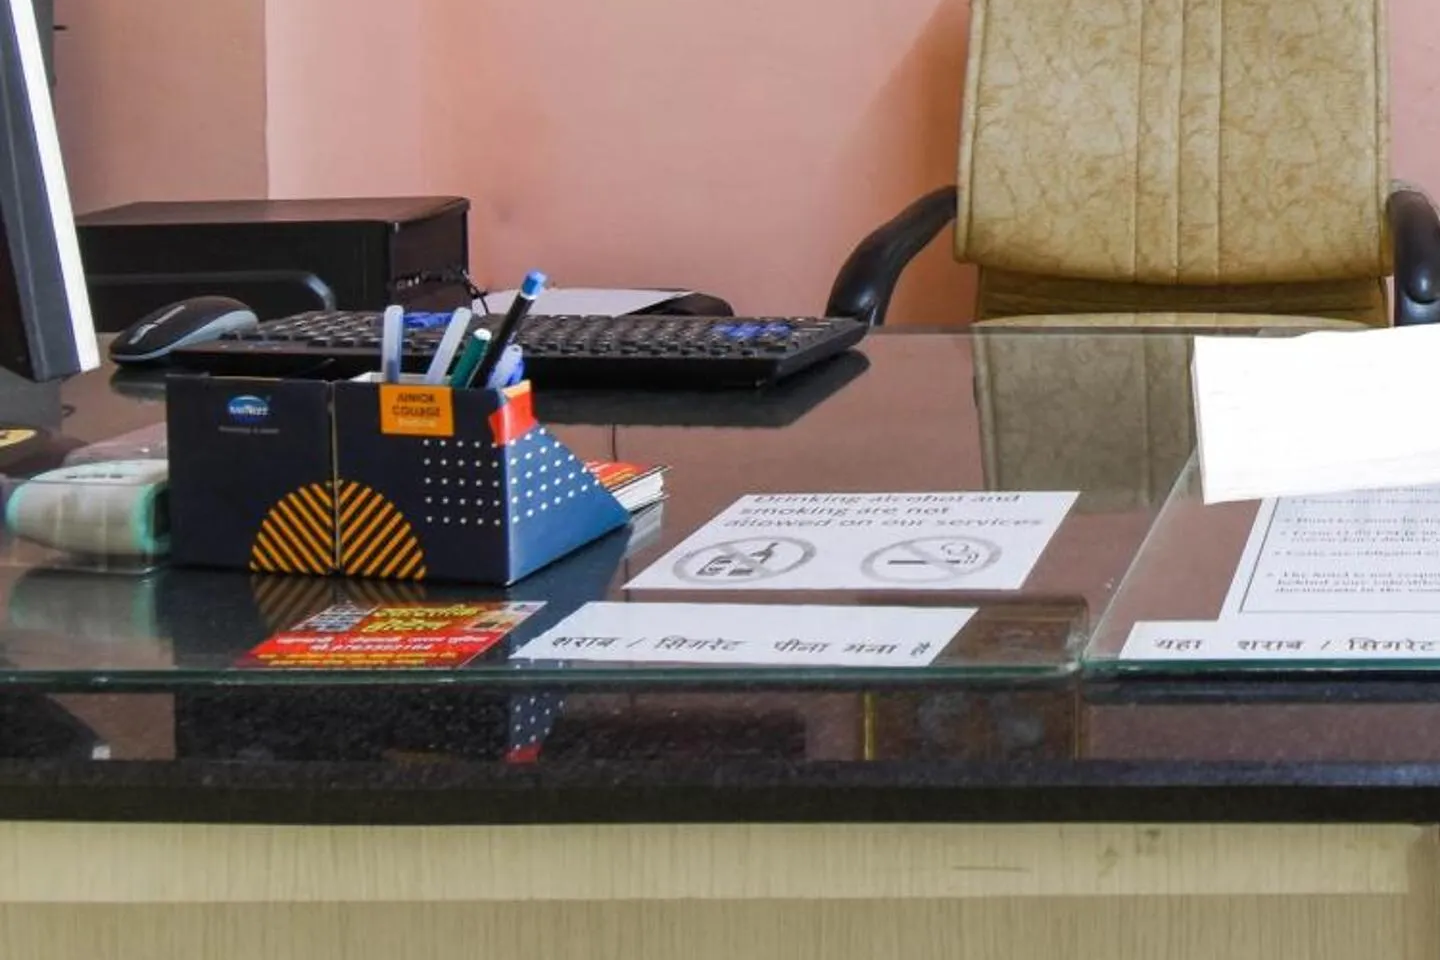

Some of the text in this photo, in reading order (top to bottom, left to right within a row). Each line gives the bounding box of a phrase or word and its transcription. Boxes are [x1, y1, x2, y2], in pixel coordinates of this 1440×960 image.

[970, 494, 1021, 502] and
[740, 507, 850, 517] smoking
[906, 507, 950, 515] not
[723, 519, 832, 528] allowed
